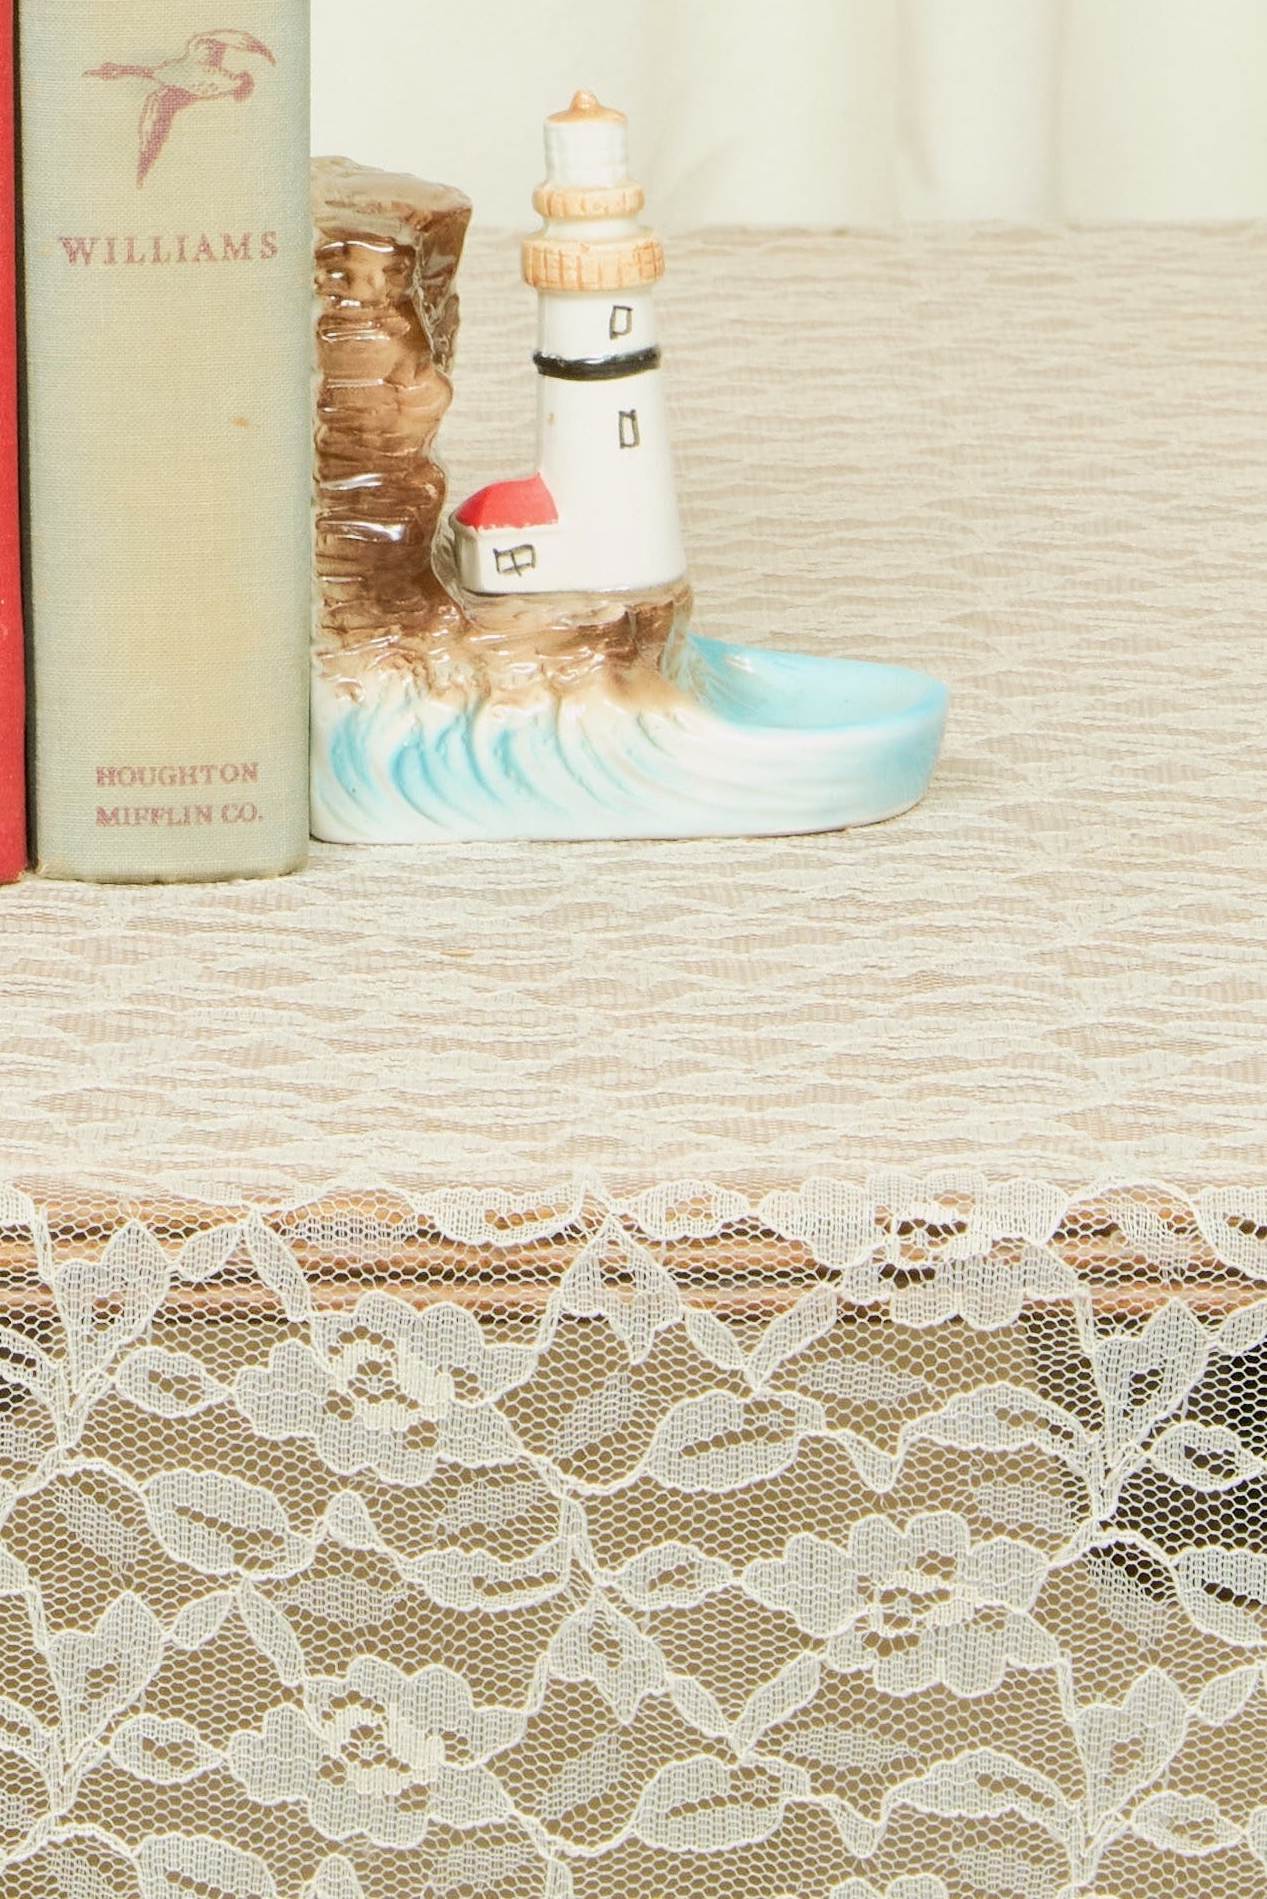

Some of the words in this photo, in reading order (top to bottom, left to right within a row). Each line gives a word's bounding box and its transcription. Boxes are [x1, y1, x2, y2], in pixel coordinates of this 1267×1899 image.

[58, 230, 279, 267] WILLIAMS
[95, 761, 260, 788] HOUGHTON
[95, 803, 214, 828] MIFFLIN
[220, 802, 264, 825] CO.
